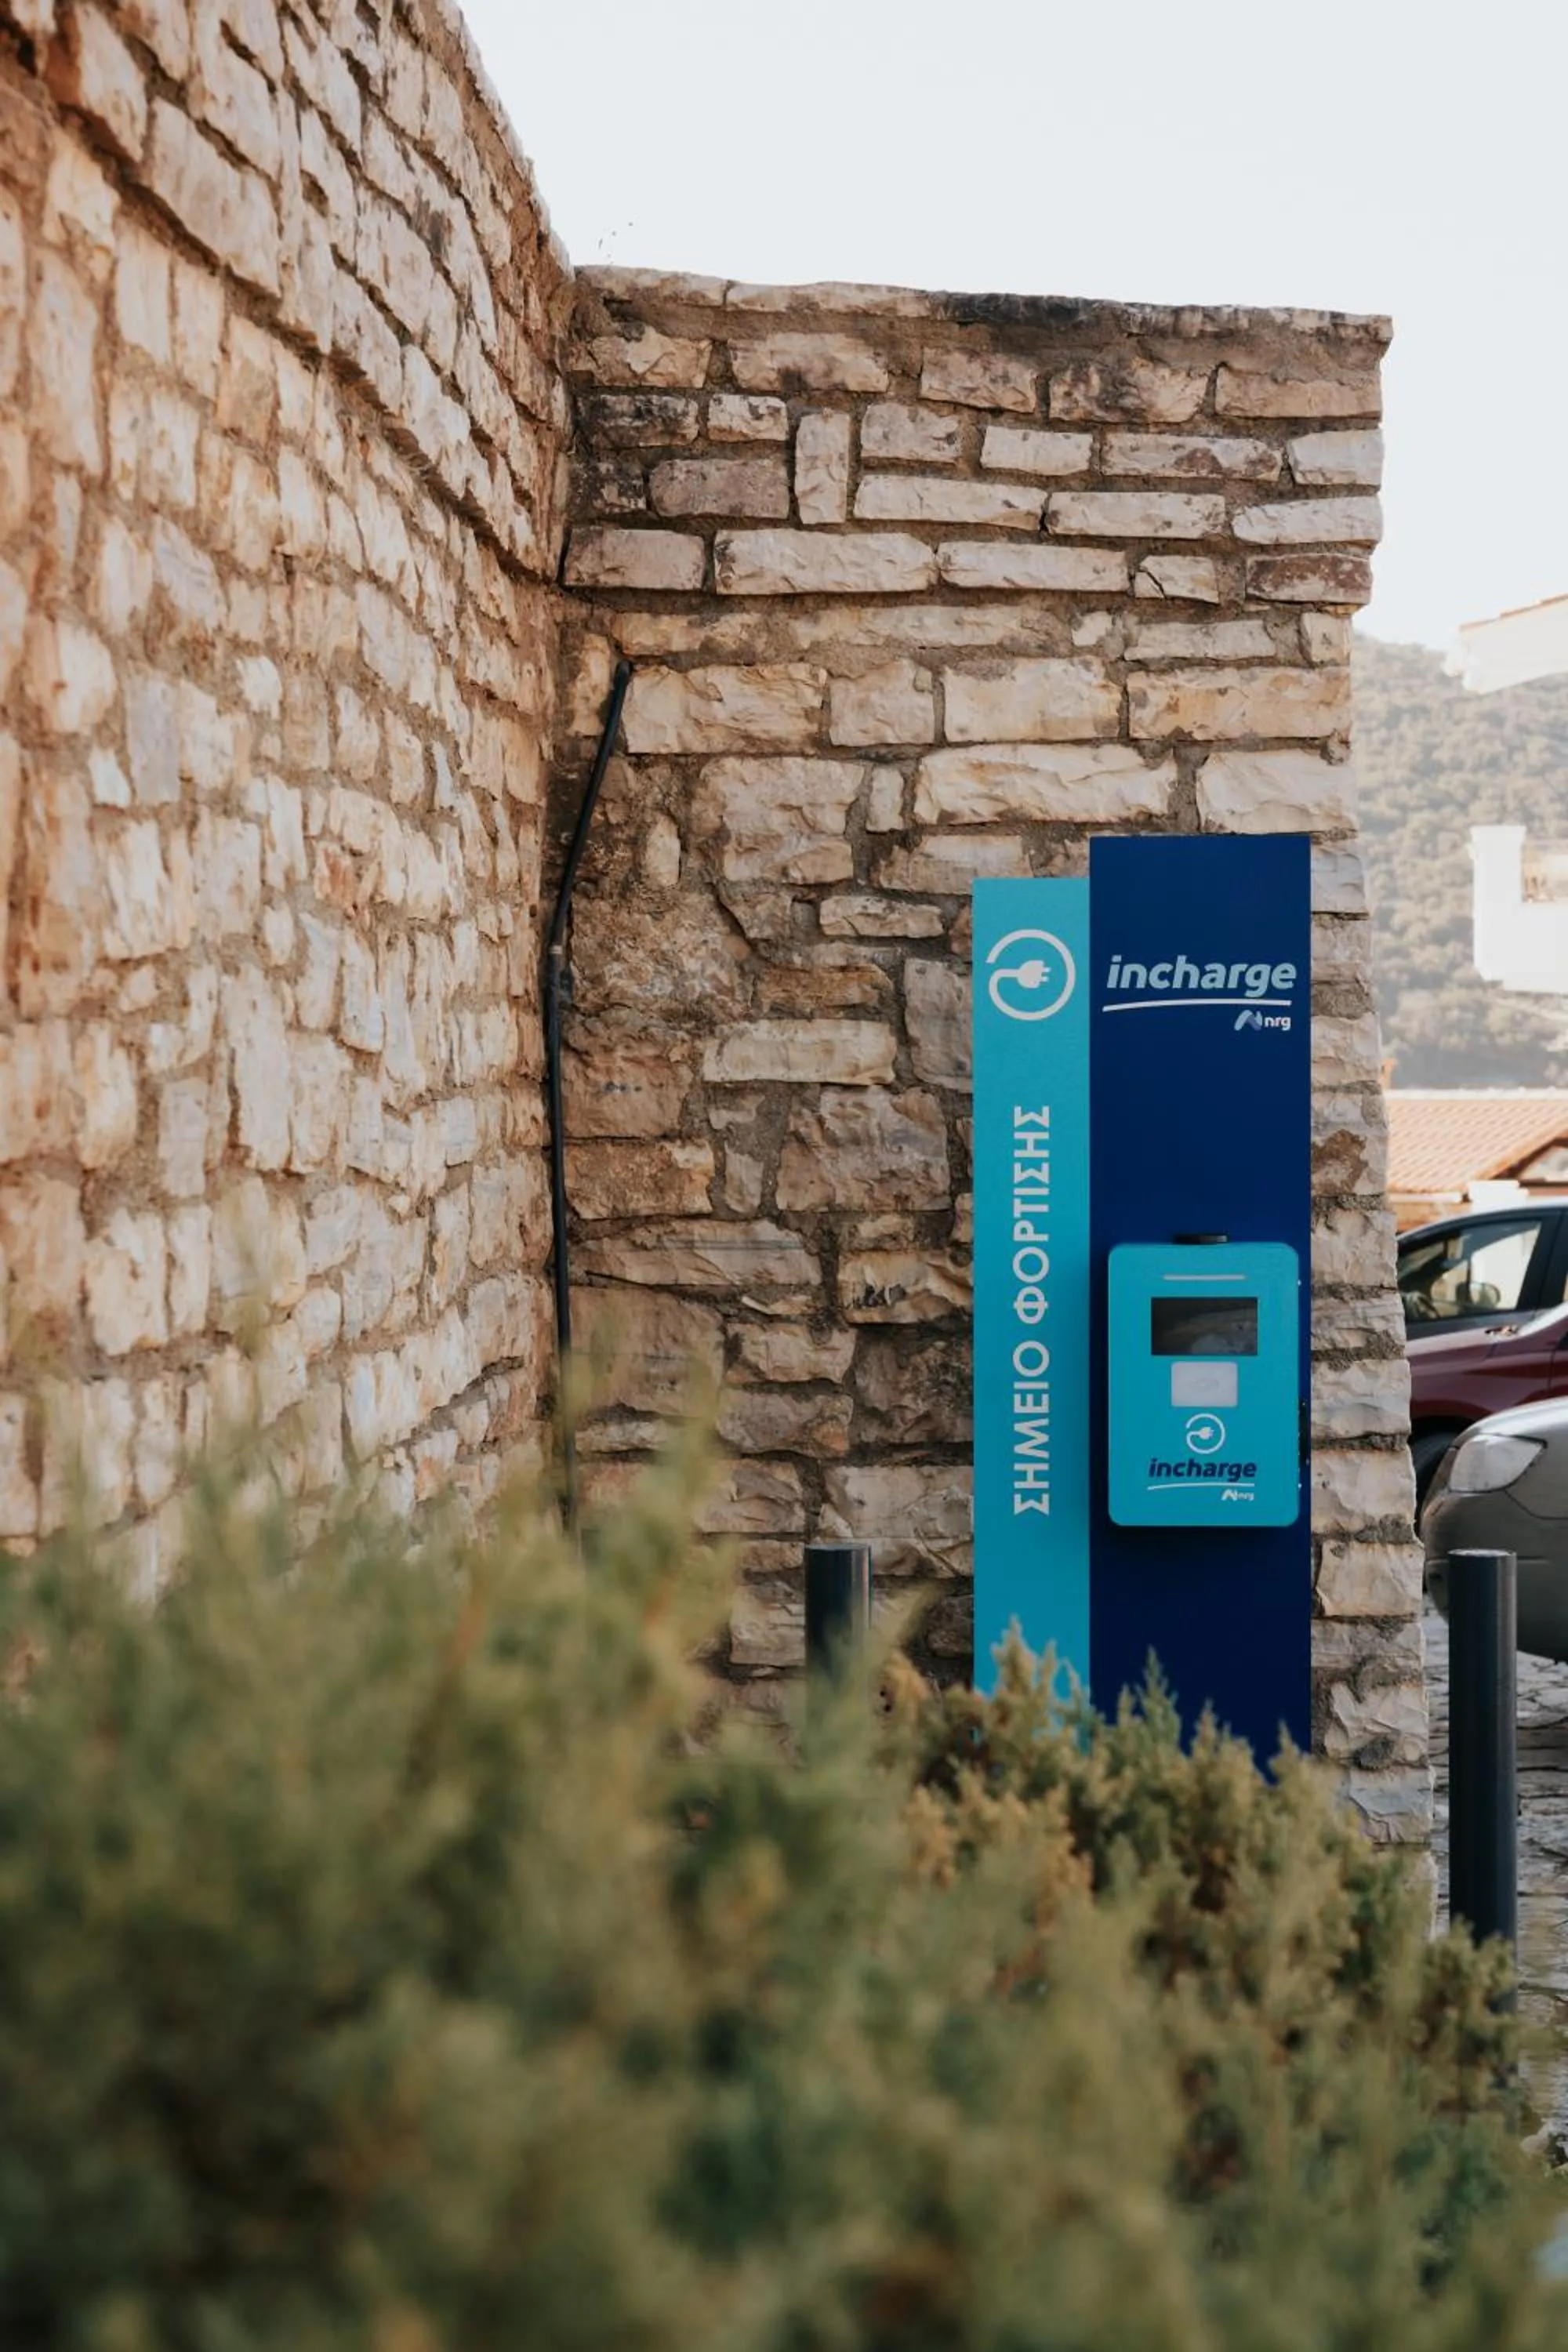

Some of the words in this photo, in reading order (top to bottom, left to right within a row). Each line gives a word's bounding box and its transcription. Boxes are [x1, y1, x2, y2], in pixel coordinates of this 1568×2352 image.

[1106, 955, 1297, 998] incharge
[1264, 1015, 1291, 1031] nrg
[1012, 1105, 1050, 1325] ΦΟΡΤΙΣΗΣ
[1012, 1340, 1050, 1516] ΣΗΜΕΙΟ
[1149, 1457, 1258, 1482] incharge
